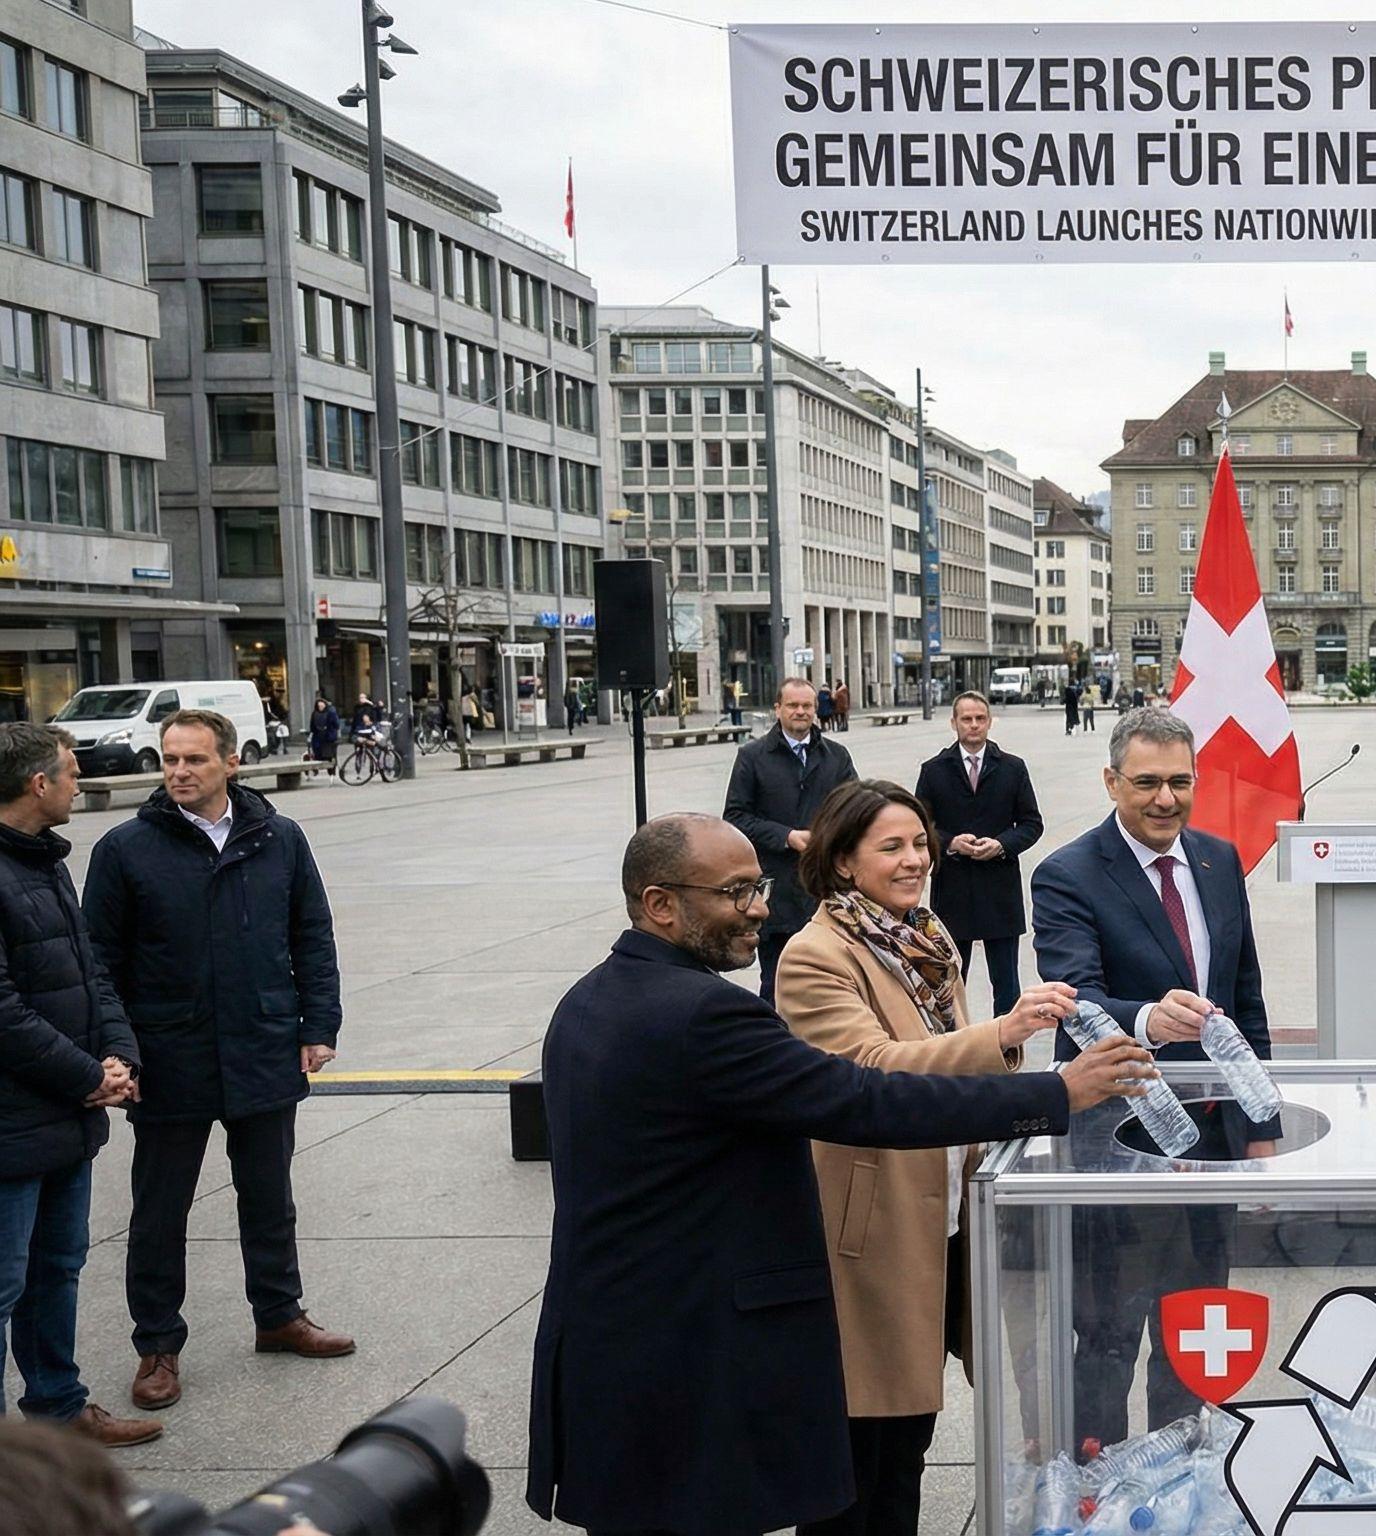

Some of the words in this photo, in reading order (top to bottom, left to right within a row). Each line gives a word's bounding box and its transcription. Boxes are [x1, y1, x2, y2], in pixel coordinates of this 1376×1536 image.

[784, 55, 1312, 113] SCHWEIZERISCHES
[775, 132, 1115, 188] GEMEINSAM
[1137, 118, 1242, 187] FÜR
[800, 210, 1025, 243] SWITZERLAND
[1037, 209, 1203, 242] LAUNCHES
